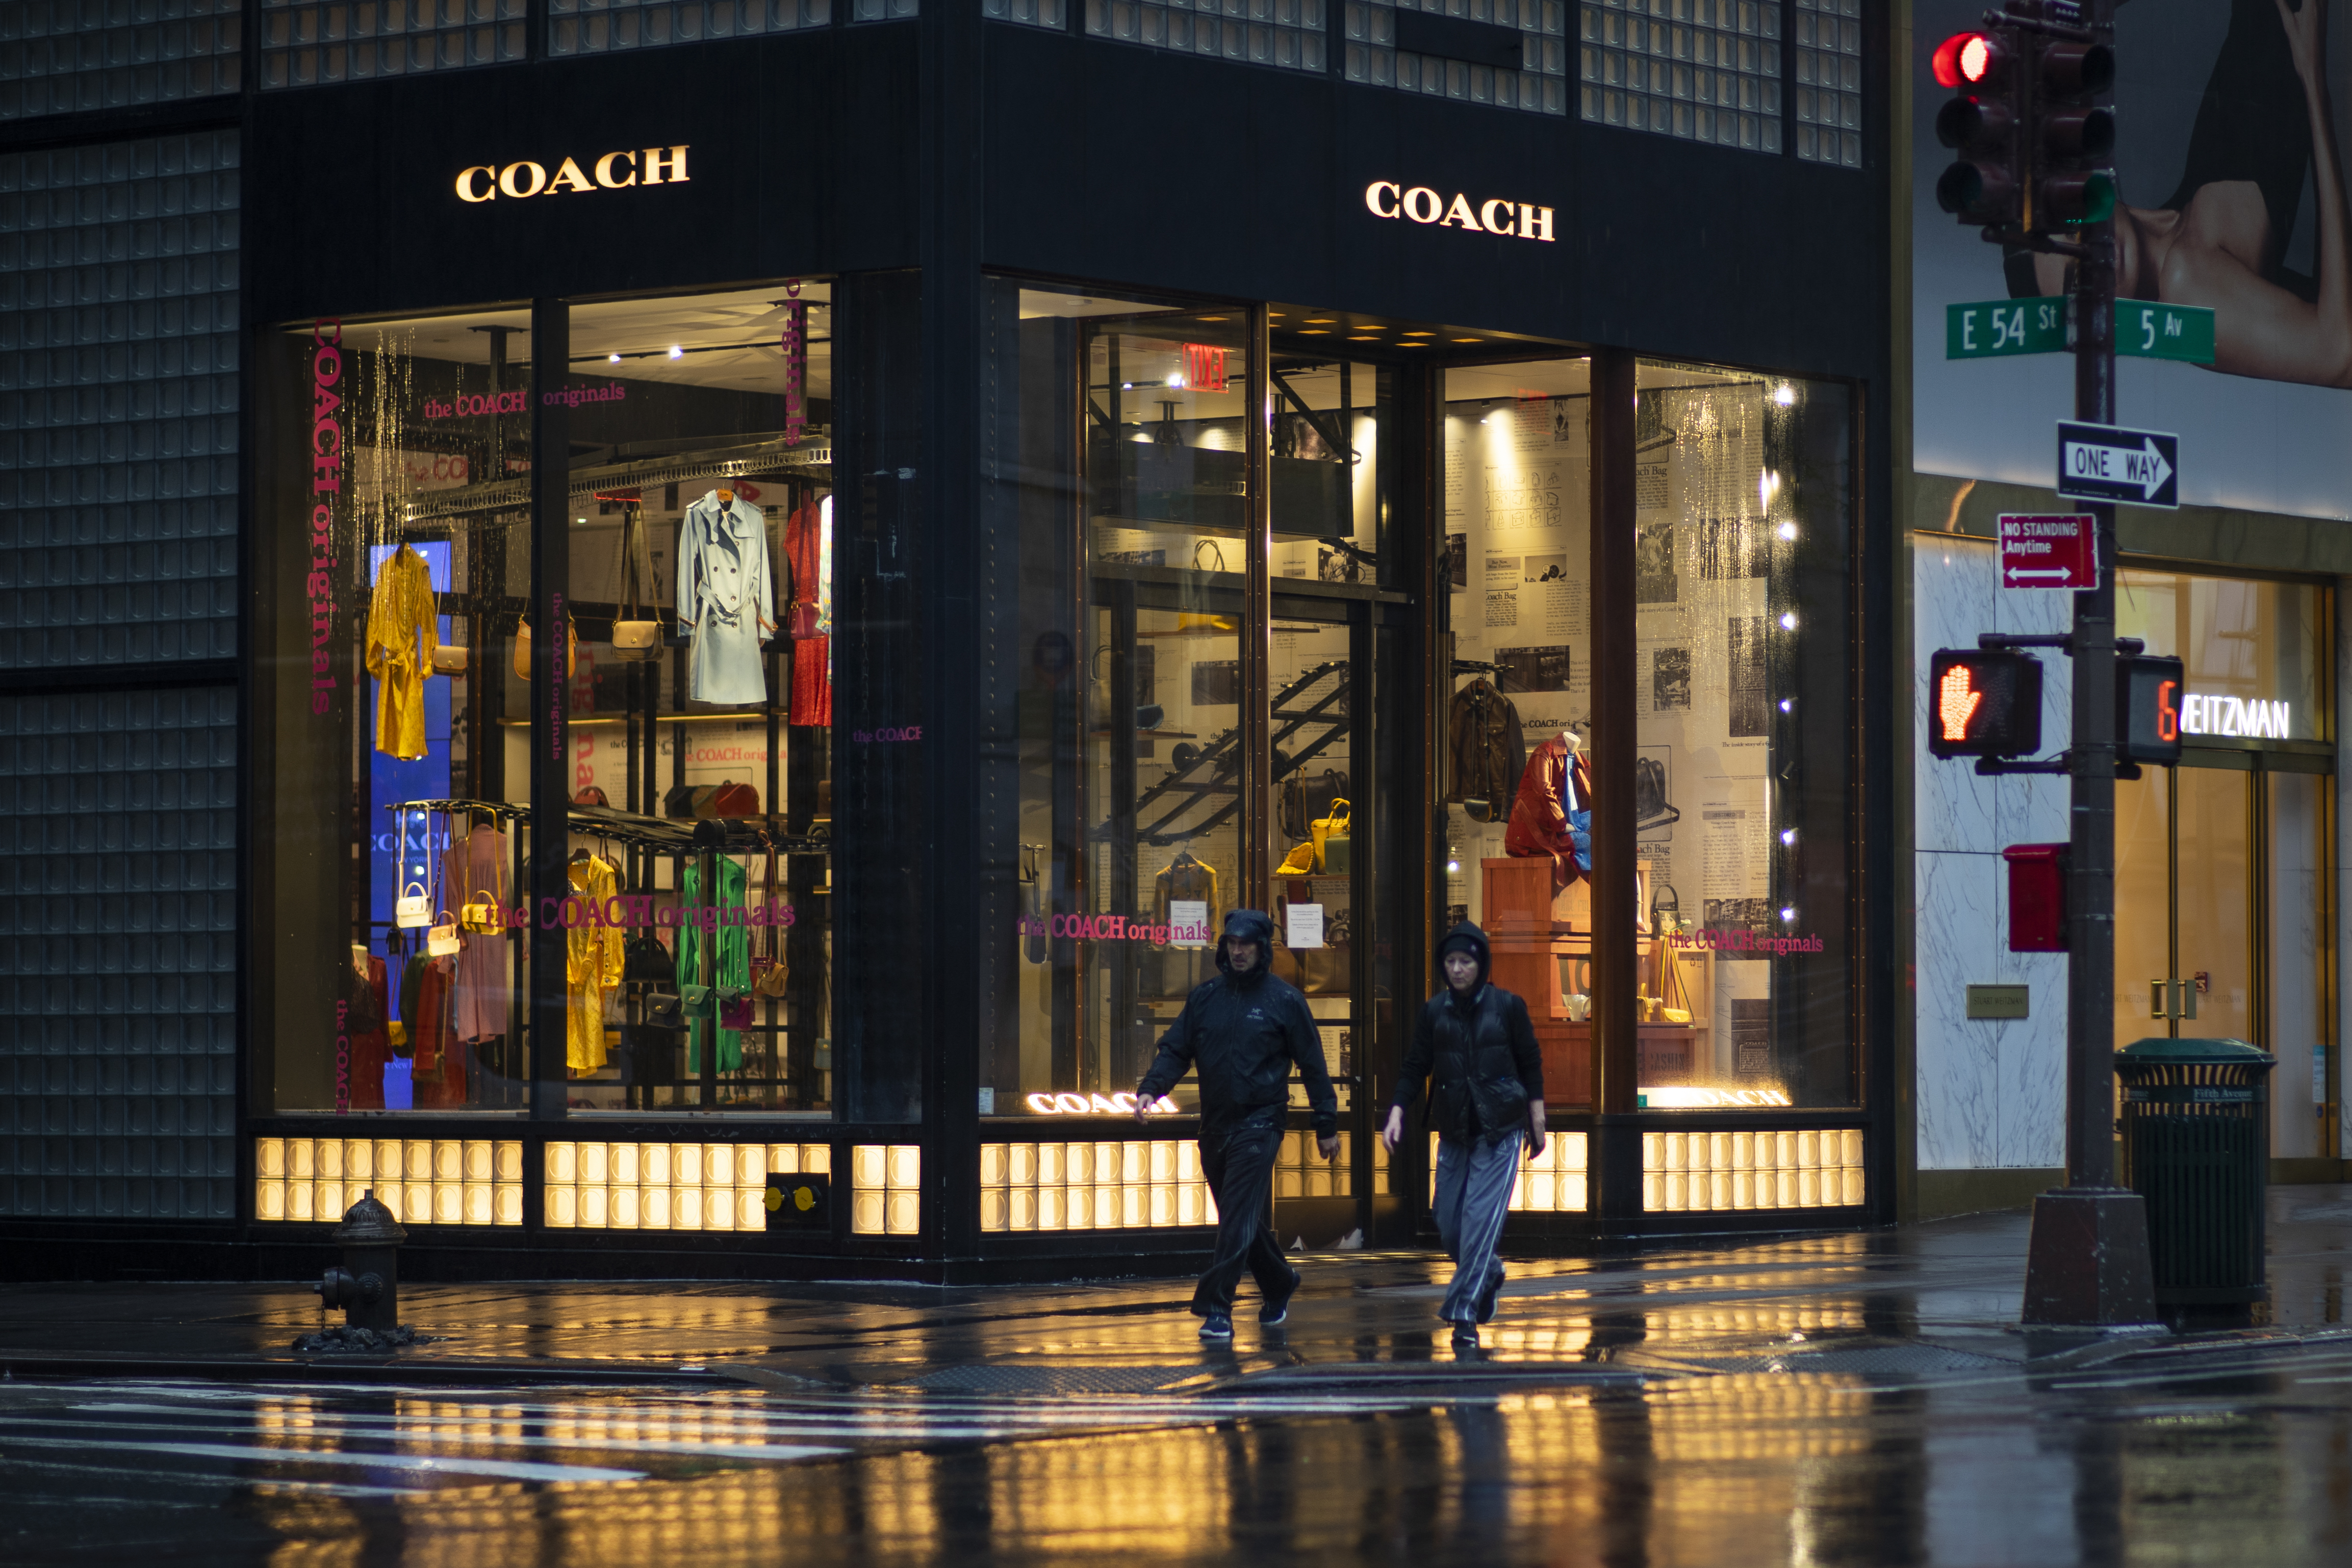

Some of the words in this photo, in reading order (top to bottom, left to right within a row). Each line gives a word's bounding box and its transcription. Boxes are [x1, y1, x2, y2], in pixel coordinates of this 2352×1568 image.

[456, 145, 690, 202] COACH
[1366, 181, 1555, 241] COACH
[1963, 310, 1977, 350] E
[1992, 306, 2026, 349] 54
[2038, 305, 2057, 329] St
[2141, 310, 2155, 350] 5
[2165, 312, 2182, 338] Av
[782, 278, 807, 446] originals
[313, 318, 342, 496] COACH
[425, 399, 451, 419] the
[455, 391, 527, 417] COACH
[543, 382, 625, 407] originals
[1652, 466, 1668, 477] Bag
[2076, 447, 2110, 477] ONE
[2126, 453, 2161, 483] WAY
[2004, 522, 2020, 536] NO
[2023, 522, 2078, 536] STANDING
[2006, 539, 2052, 556] Anytime
[307, 504, 337, 714] originals
[553, 593, 562, 616] the
[1504, 592, 1517, 601] Bag
[552, 621, 563, 684] COACH
[551, 687, 562, 760] originals
[853, 729, 873, 743] the
[1529, 719, 1558, 728] COACH
[696, 747, 742, 762] COACH
[1654, 843, 1670, 856] Bag
[485, 899, 528, 929] the
[541, 895, 653, 930] COACH
[658, 897, 796, 934] originals
[1016, 914, 1046, 937] the
[1051, 914, 1125, 940] COACH
[1128, 919, 1212, 945] originals
[1669, 930, 1692, 949] the
[1695, 928, 1754, 950] COACH
[1757, 932, 1824, 956] originals
[1973, 996, 1993, 1006] STUART
[1995, 996, 2023, 1006] WEITZMAN
[2195, 994, 2212, 1004] TUART
[337, 999, 348, 1031] the
[336, 1036, 348, 1116] COACH
[392, 1060, 408, 1070] New
[2193, 1088, 2219, 1098] Fifth
[2221, 1088, 2253, 1098] Avenue
